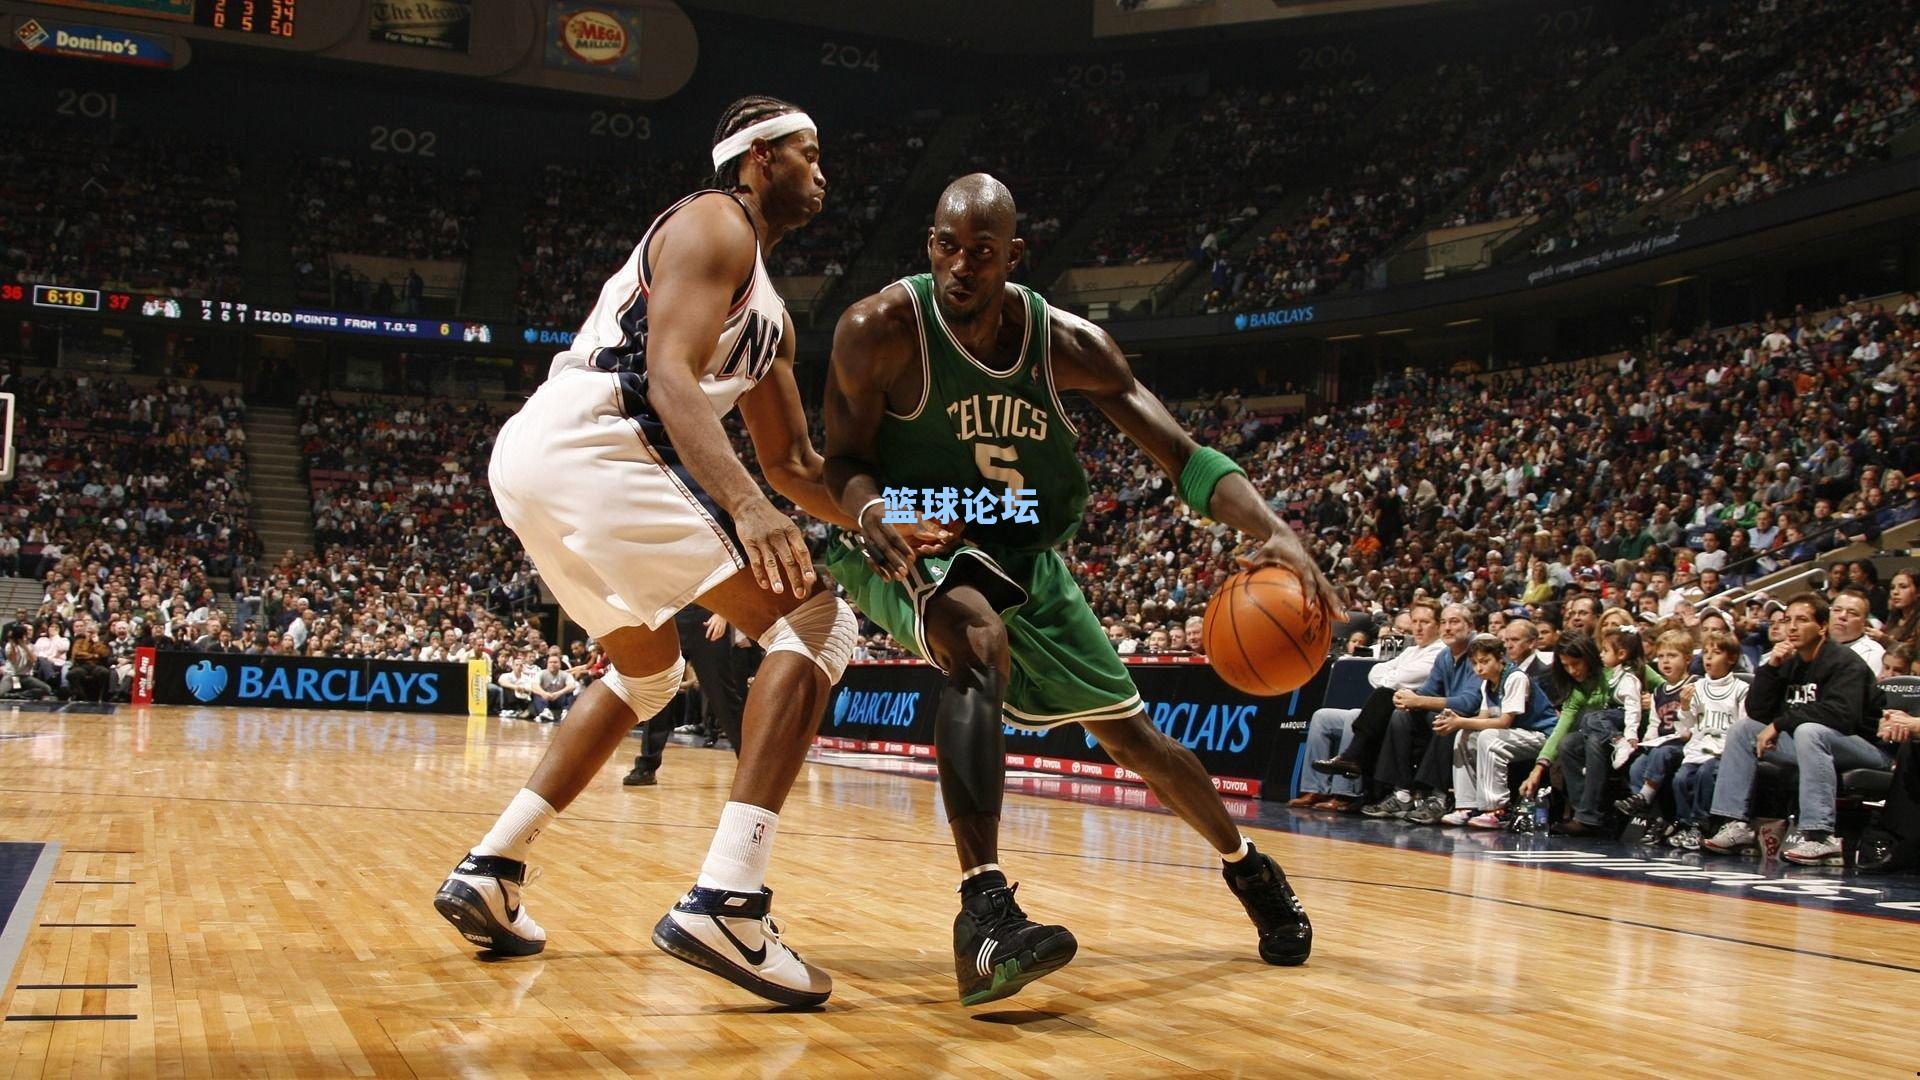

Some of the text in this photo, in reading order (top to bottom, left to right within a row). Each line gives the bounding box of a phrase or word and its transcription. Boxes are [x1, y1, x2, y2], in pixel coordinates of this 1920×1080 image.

[241, 17, 252, 31] 5
[373, 2, 412, 20] The
[1536, 6, 1593, 38] 207
[56, 30, 138, 56] Domino's
[577, 21, 622, 41] MEGA
[821, 42, 880, 73] 204
[1299, 43, 1357, 71] 206
[1067, 61, 1126, 90] 205
[57, 89, 118, 119] 201
[590, 111, 651, 141] 203
[370, 126, 437, 157] 202
[1, 284, 130, 310] 36 6:19 37
[202, 309, 212, 321] 2
[238, 312, 245, 323] 1
[254, 310, 293, 323] IZOD
[295, 313, 338, 326] POINTS
[344, 318, 377, 330] FROM
[440, 323, 450, 336] 6
[1250, 305, 1314, 328] BARCLAYS
[946, 394, 1049, 441] CELTICS
[974, 442, 1024, 512] 5
[238, 666, 438, 705] BARCLAYS
[847, 691, 920, 727] BARCLAYS
[1697, 709, 1735, 732] CLTICS
[1145, 701, 1259, 753] RCLAYS
[1280, 720, 1307, 730] MARQUIS
[1007, 755, 1025, 765] TOYOTA
[1042, 759, 1062, 769] TOYOTA
[1081, 764, 1103, 775] TOYOTA
[1222, 780, 1249, 792] TOYOTA
